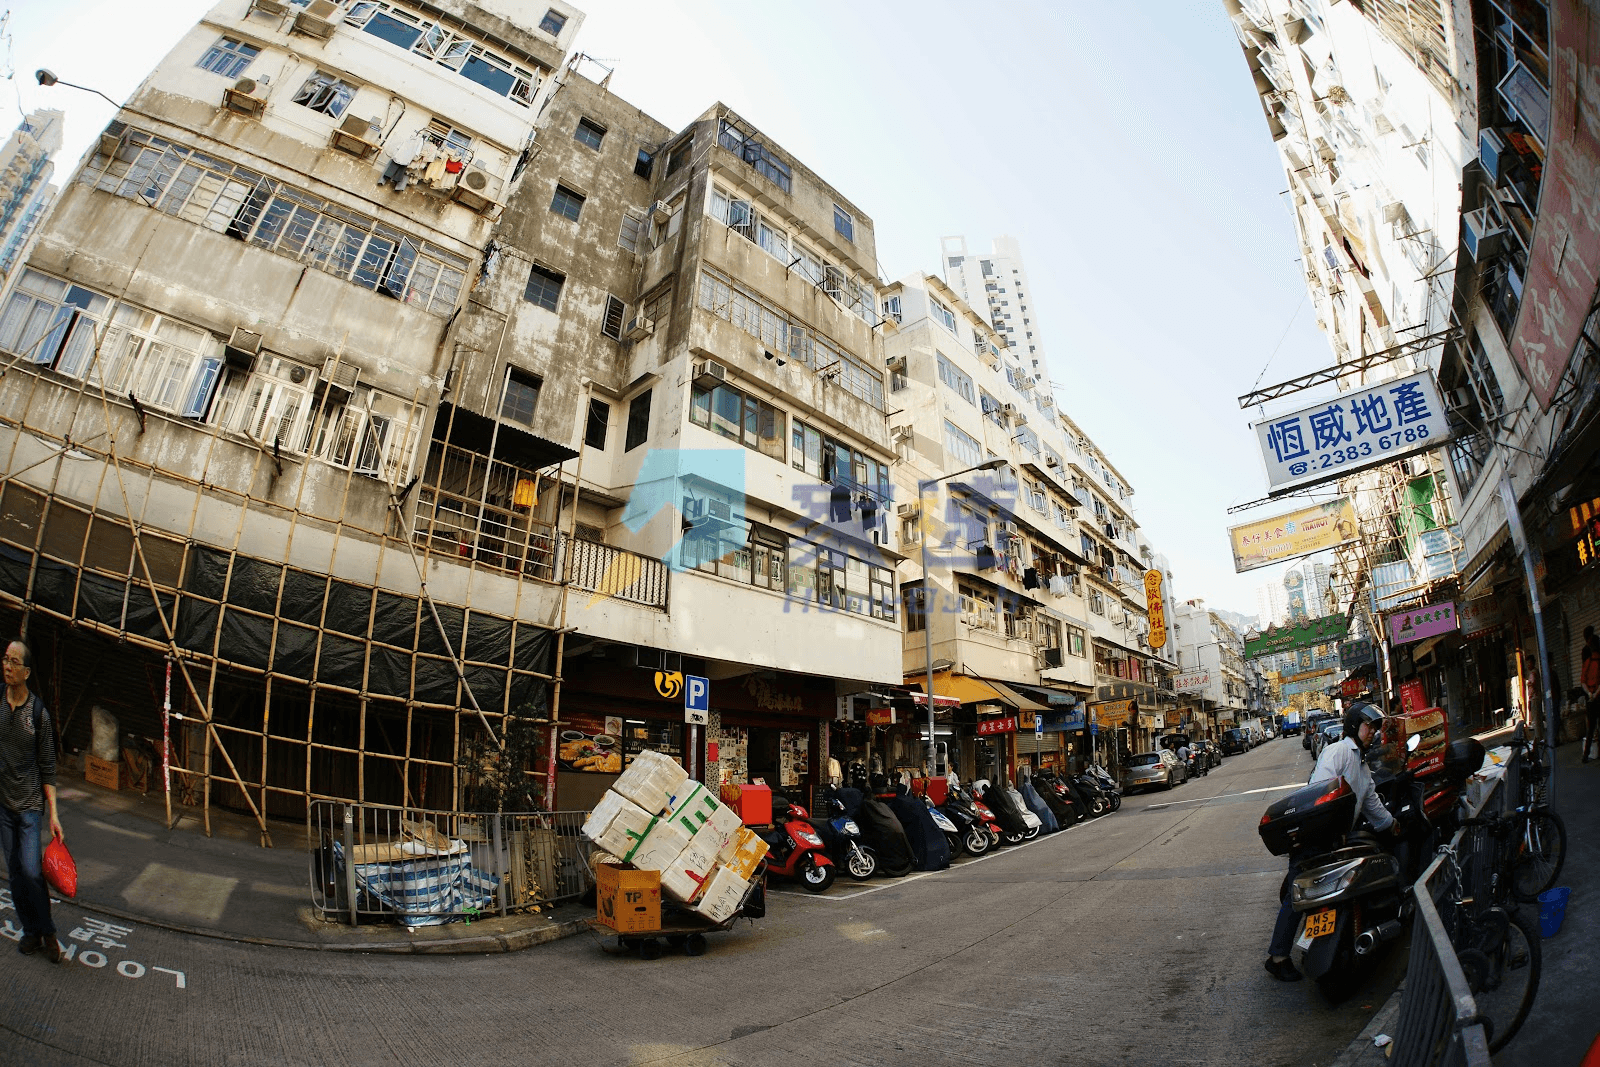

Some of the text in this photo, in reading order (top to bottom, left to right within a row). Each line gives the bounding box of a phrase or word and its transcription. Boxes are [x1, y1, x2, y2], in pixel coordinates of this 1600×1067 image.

[1267, 381, 1432, 463] 恆威地產
[1378, 424, 1430, 450] 6788
[689, 679, 705, 707] P
[1035, 716, 1043, 733] P
[786, 835, 797, 850] 232
[625, 891, 641, 903] TP
[1313, 912, 1329, 925] MS
[1306, 921, 1335, 938] 2847
